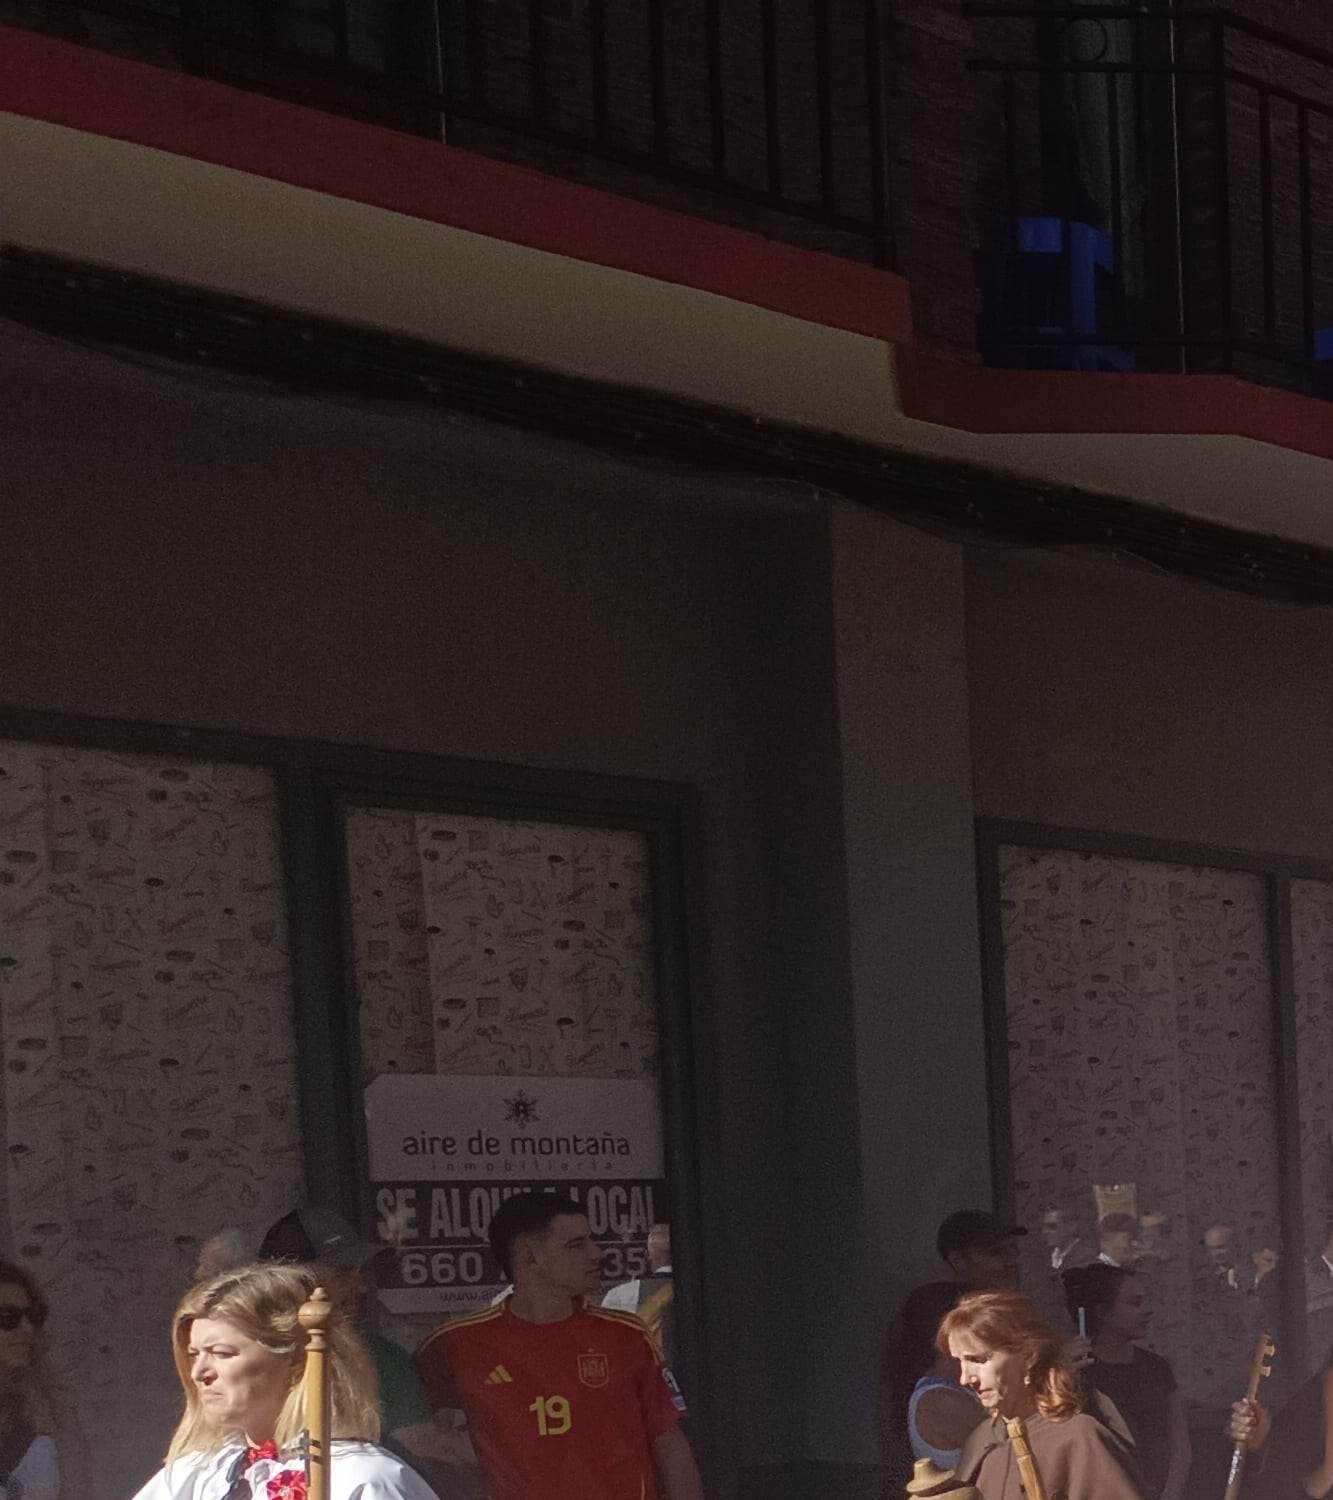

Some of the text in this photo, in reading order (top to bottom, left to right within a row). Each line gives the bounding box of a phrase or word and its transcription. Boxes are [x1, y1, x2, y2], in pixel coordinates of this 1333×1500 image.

[403, 1129, 631, 1156] aire de montaña
[431, 1160, 614, 1172] inmobiliaria
[376, 1187, 420, 1241] SE
[401, 1252, 483, 1285] 660
[528, 1395, 573, 1436] 19
